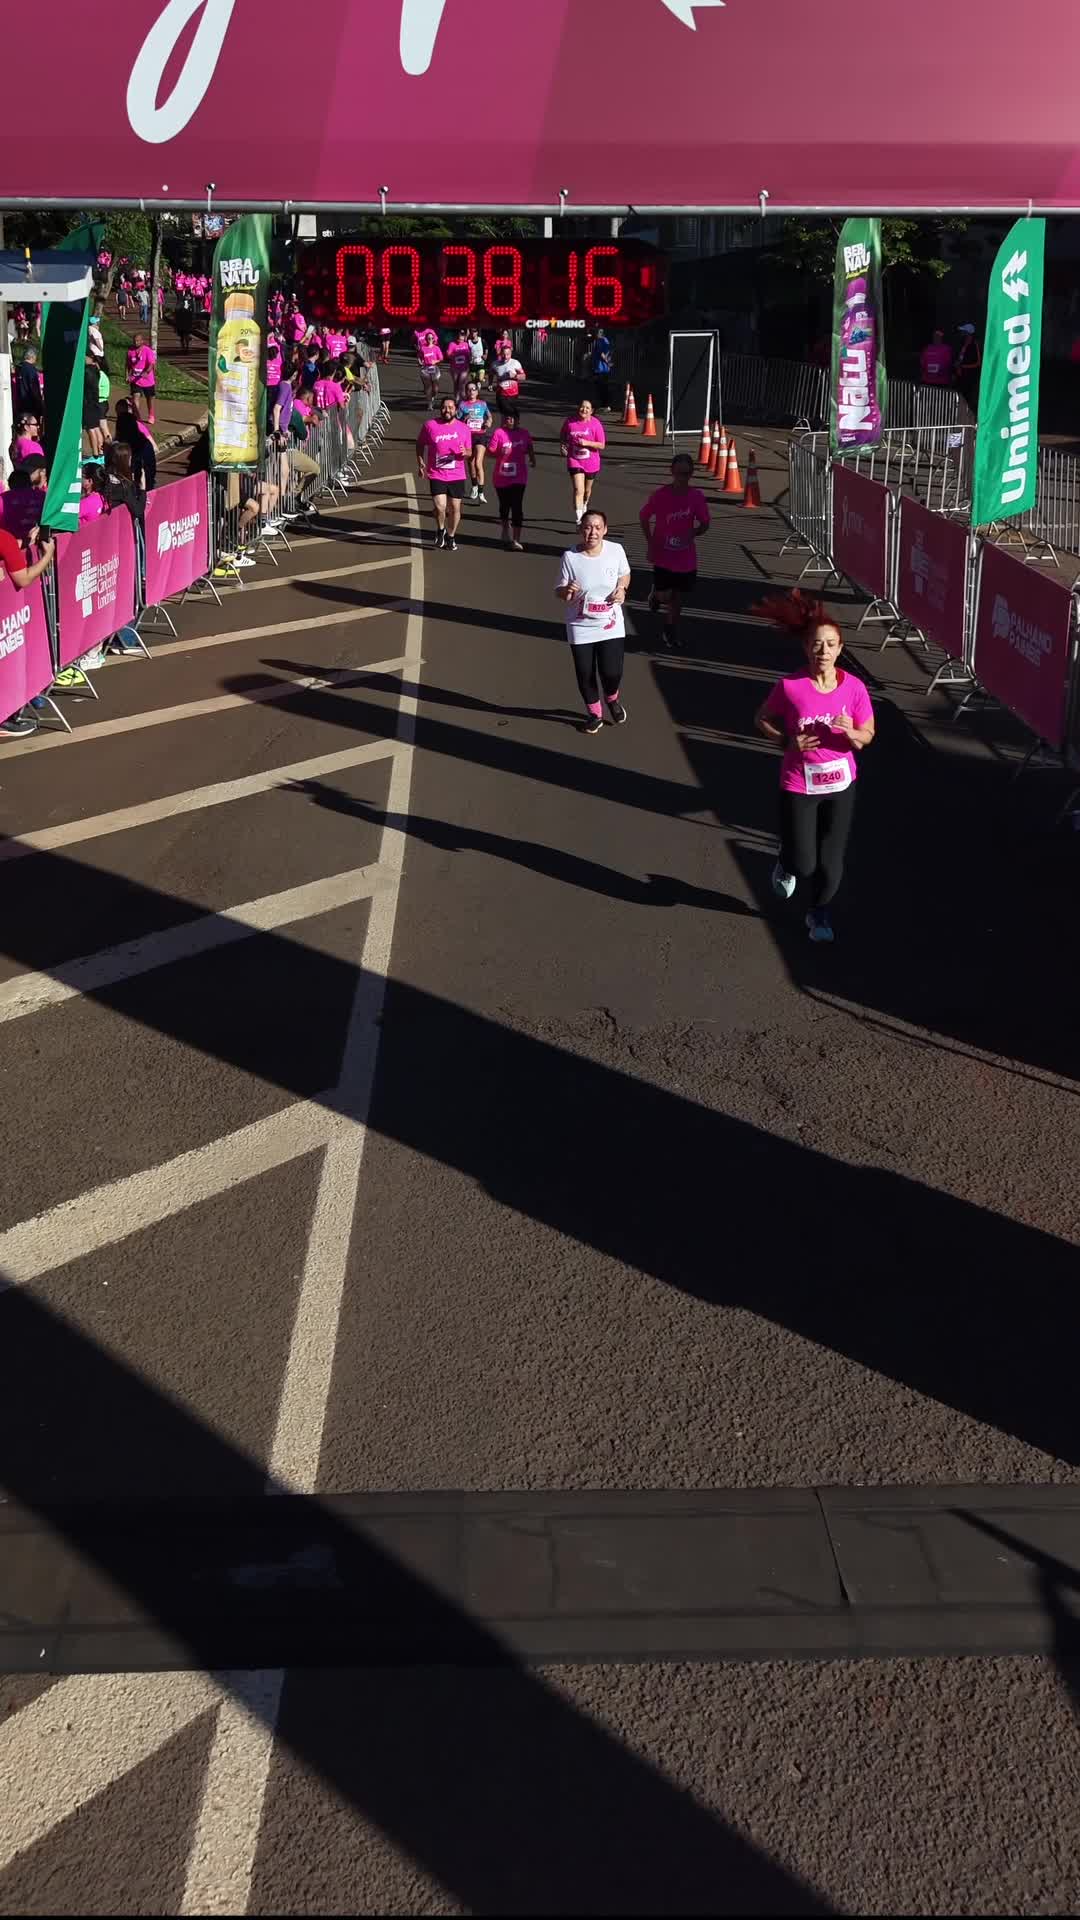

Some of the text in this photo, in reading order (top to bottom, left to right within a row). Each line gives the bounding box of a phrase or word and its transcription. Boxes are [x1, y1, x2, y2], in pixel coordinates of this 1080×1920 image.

[219, 258, 253, 273] BEBA
[220, 270, 260, 287] NATU
[336, 245, 623, 315] 00 38 16
[1000, 313, 1031, 504] Unimed
[815, 771, 841, 783] 1240
